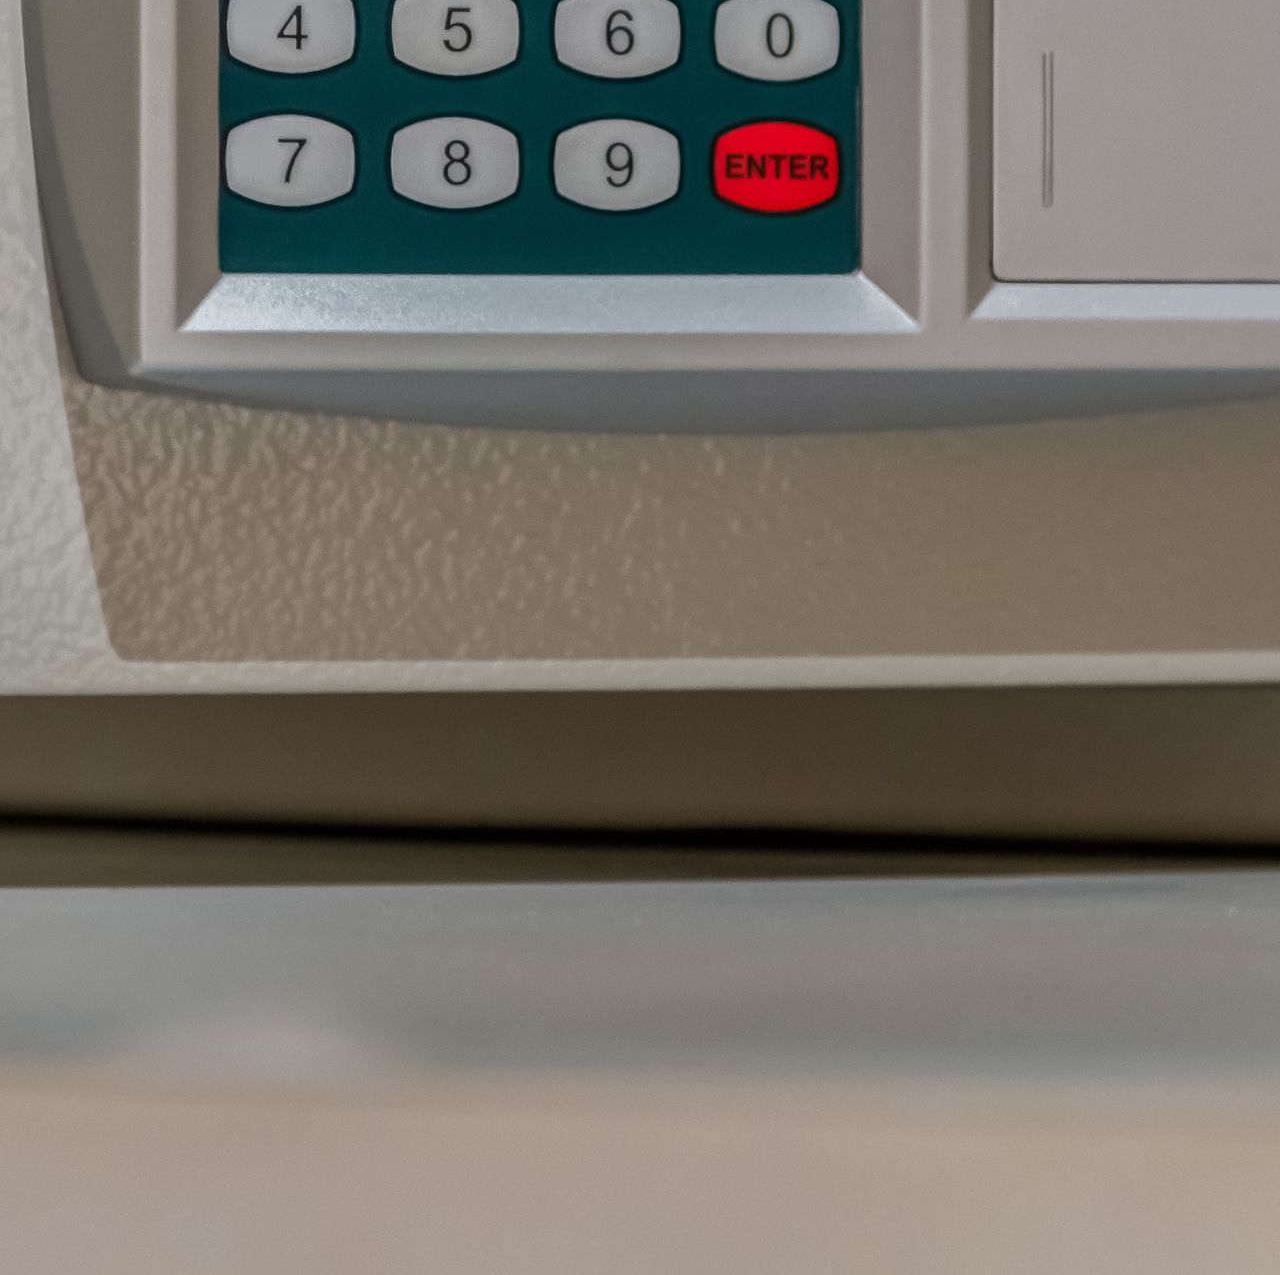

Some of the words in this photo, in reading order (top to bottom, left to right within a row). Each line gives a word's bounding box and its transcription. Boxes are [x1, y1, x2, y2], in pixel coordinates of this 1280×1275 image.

[276, 4, 308, 50] 4
[443, 7, 473, 53] 5
[605, 9, 635, 56] 6
[765, 12, 795, 59] 0
[277, 138, 308, 184] 7
[442, 139, 472, 186] 8
[605, 141, 634, 188] 9
[724, 153, 829, 181] ENTER
